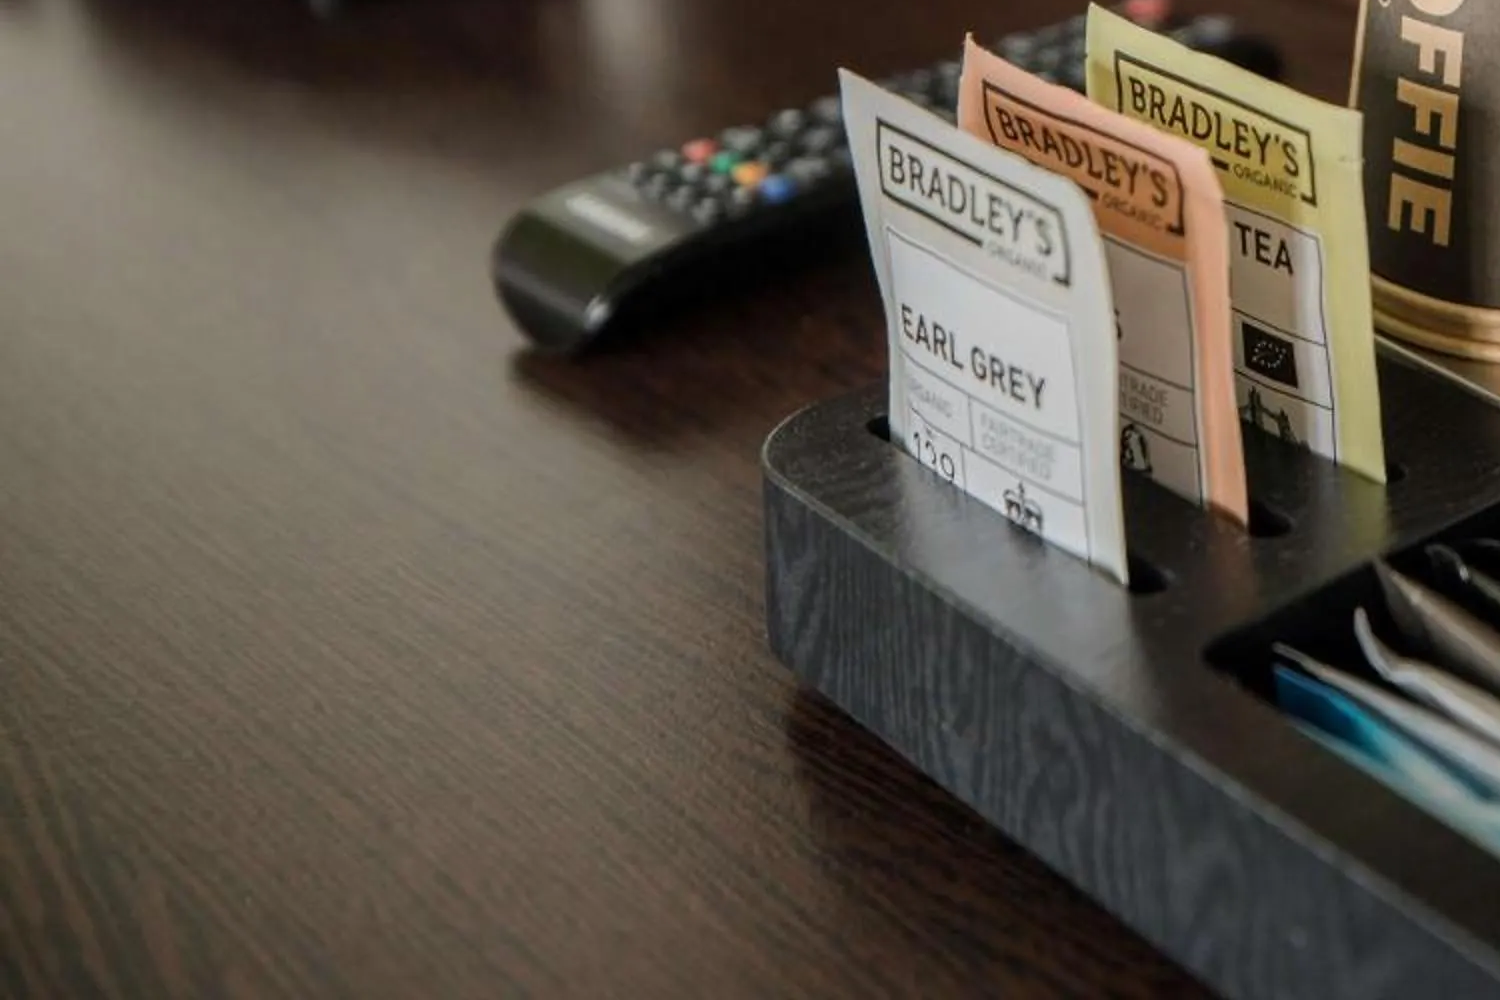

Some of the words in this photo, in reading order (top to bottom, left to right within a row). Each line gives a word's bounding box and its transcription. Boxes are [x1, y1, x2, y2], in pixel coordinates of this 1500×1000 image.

[995, 106, 1170, 208] BRADLEY'S
[1128, 76, 1300, 178] BRADLEY'S
[887, 144, 1055, 256] BRADLEY'S
[1232, 162, 1298, 199] ORGANIC
[1233, 220, 1294, 276] TEA
[901, 303, 964, 371] EARL
[970, 345, 1046, 410] GREY
